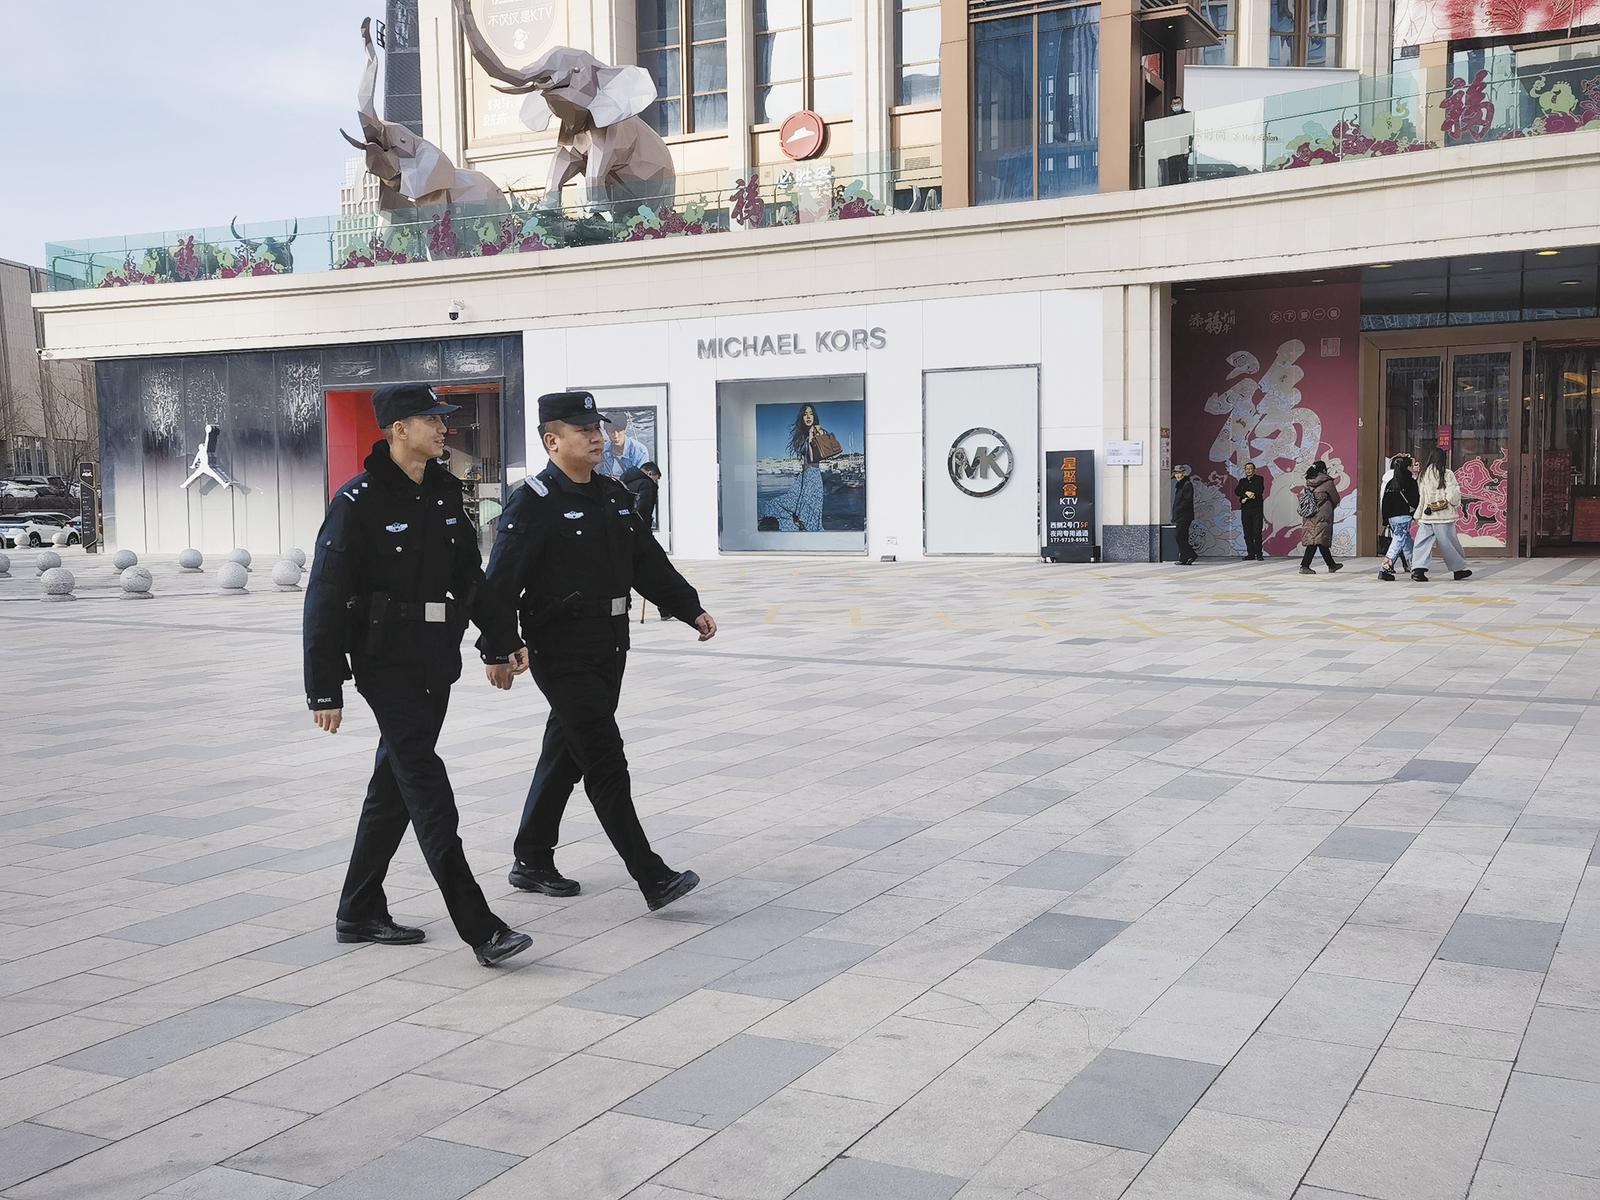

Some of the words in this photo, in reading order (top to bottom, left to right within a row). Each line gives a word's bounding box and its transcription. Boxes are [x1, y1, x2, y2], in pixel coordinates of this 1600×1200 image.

[697, 333, 807, 359] MICHAEL
[815, 327, 887, 352] KORS
[953, 446, 1005, 480] MK
